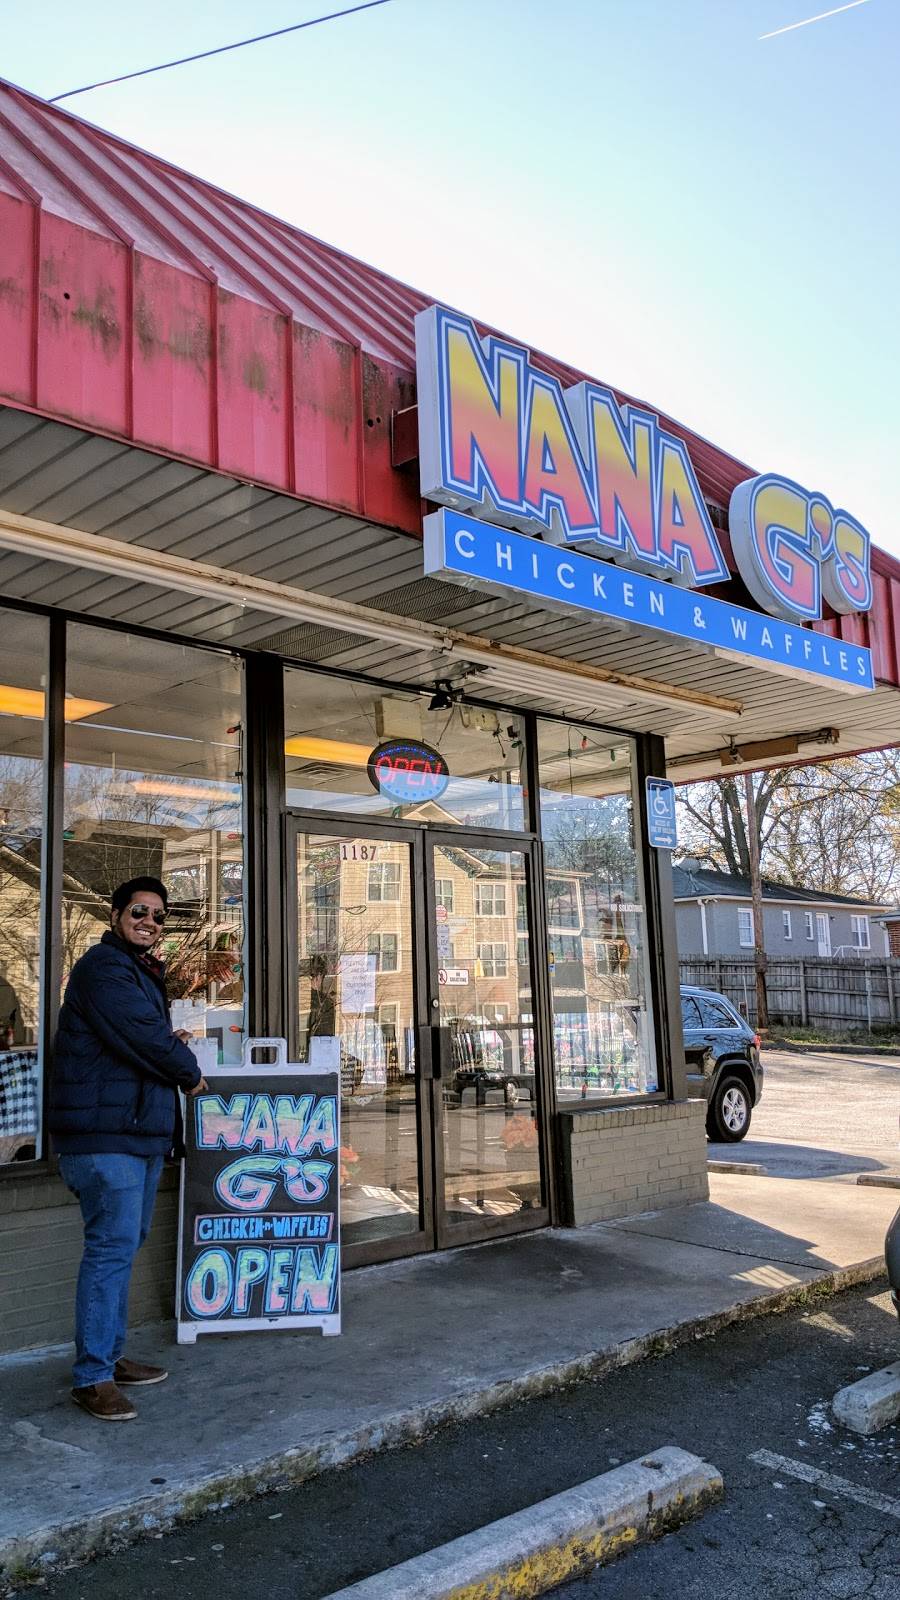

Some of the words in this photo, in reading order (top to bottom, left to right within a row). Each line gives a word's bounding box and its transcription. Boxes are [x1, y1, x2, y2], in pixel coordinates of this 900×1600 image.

[438, 307, 731, 586] NANA
[747, 474, 873, 620] G'S
[454, 529, 665, 616] CHICKEN
[693, 607, 706, 628] &
[731, 617, 866, 676] WAFFLES
[374, 755, 443, 786] OPEN
[342, 844, 377, 861] 1187
[196, 1095, 338, 1155] NANA
[187, 1244, 339, 1319] OPEN
